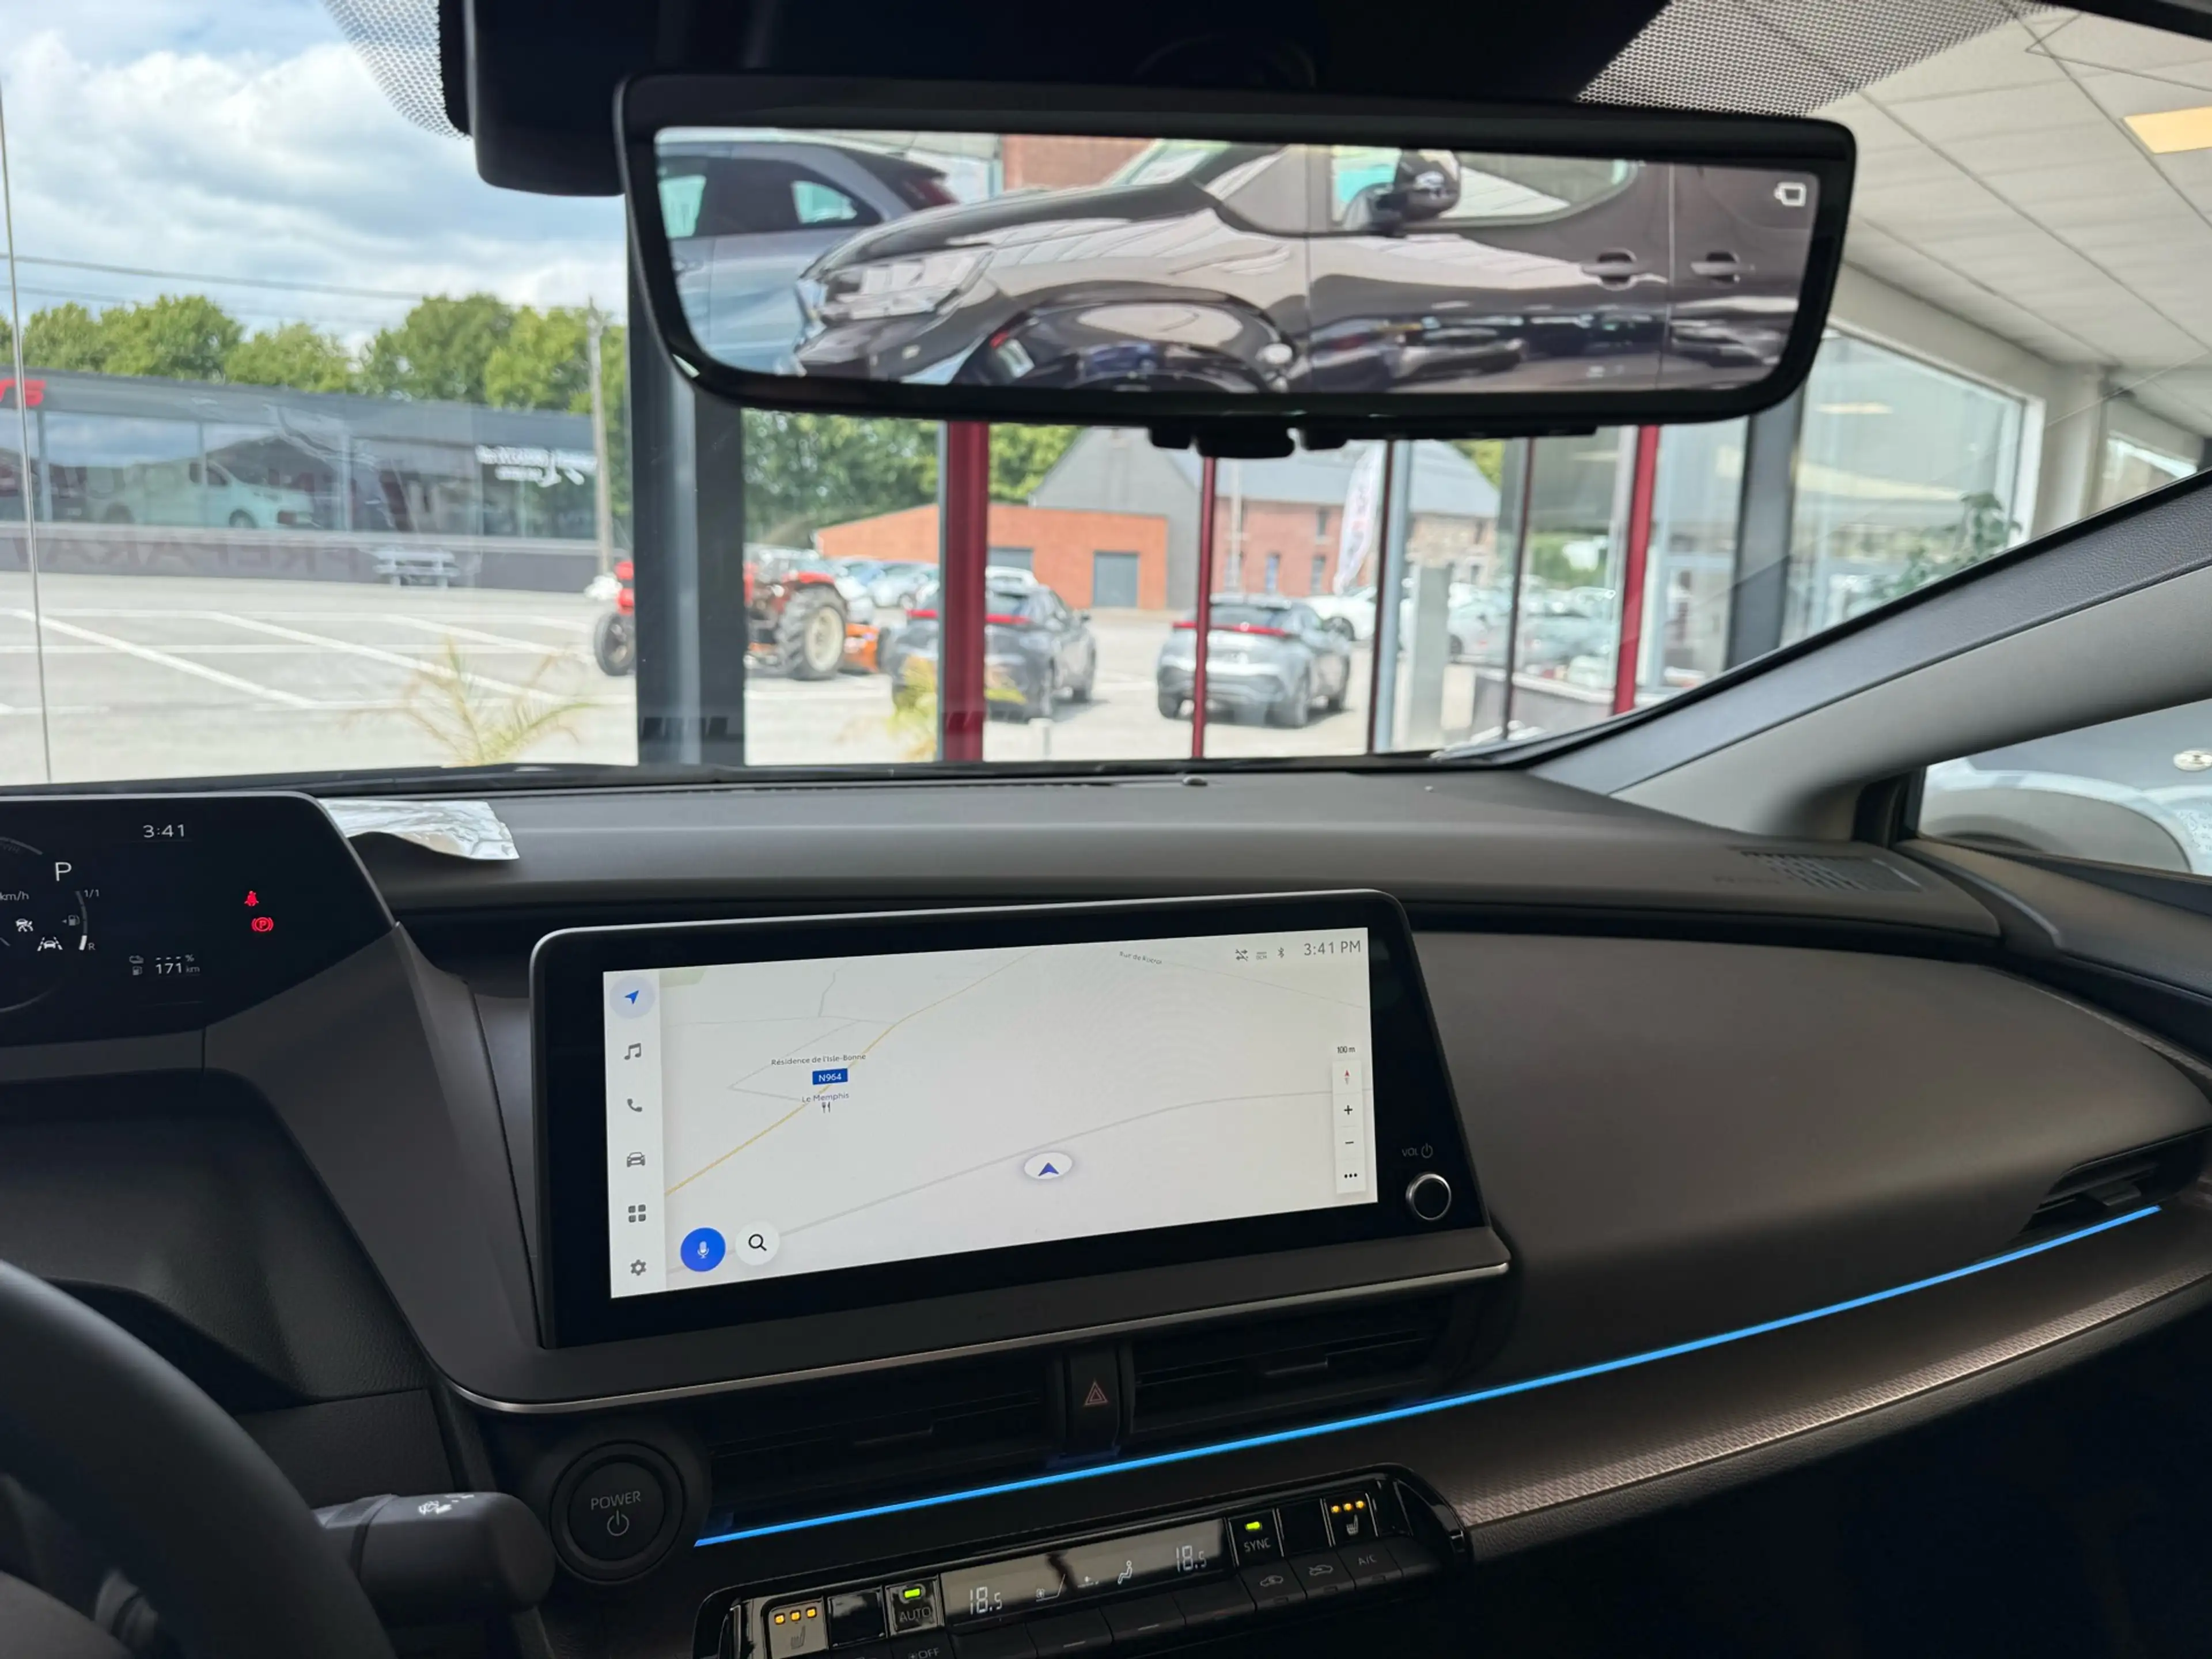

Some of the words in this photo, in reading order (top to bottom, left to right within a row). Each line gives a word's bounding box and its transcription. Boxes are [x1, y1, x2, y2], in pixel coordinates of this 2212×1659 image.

[143, 823, 184, 838] 3:41
[55, 862, 72, 881] P
[0, 891, 29, 900] km/h
[84, 889, 99, 898] 1/1
[88, 942, 96, 950] R
[1304, 942, 1334, 956] 3:41
[1340, 940, 1361, 953] PM
[156, 962, 182, 974] 171
[1337, 1046, 1347, 1054] 100
[771, 1057, 810, 1066] Résidence
[819, 1073, 842, 1082] N964
[813, 1093, 849, 1101] Memphis
[1402, 1147, 1419, 1157] VOL
[591, 1490, 641, 1510] POWER
[1244, 1537, 1271, 1552] SYNC
[1176, 1545, 1207, 1572] 18.5
[1358, 1555, 1377, 1566] A/C
[969, 1586, 1002, 1615] 18.5
[899, 1607, 931, 1622] AUTO
[918, 1647, 940, 1658] OFF
